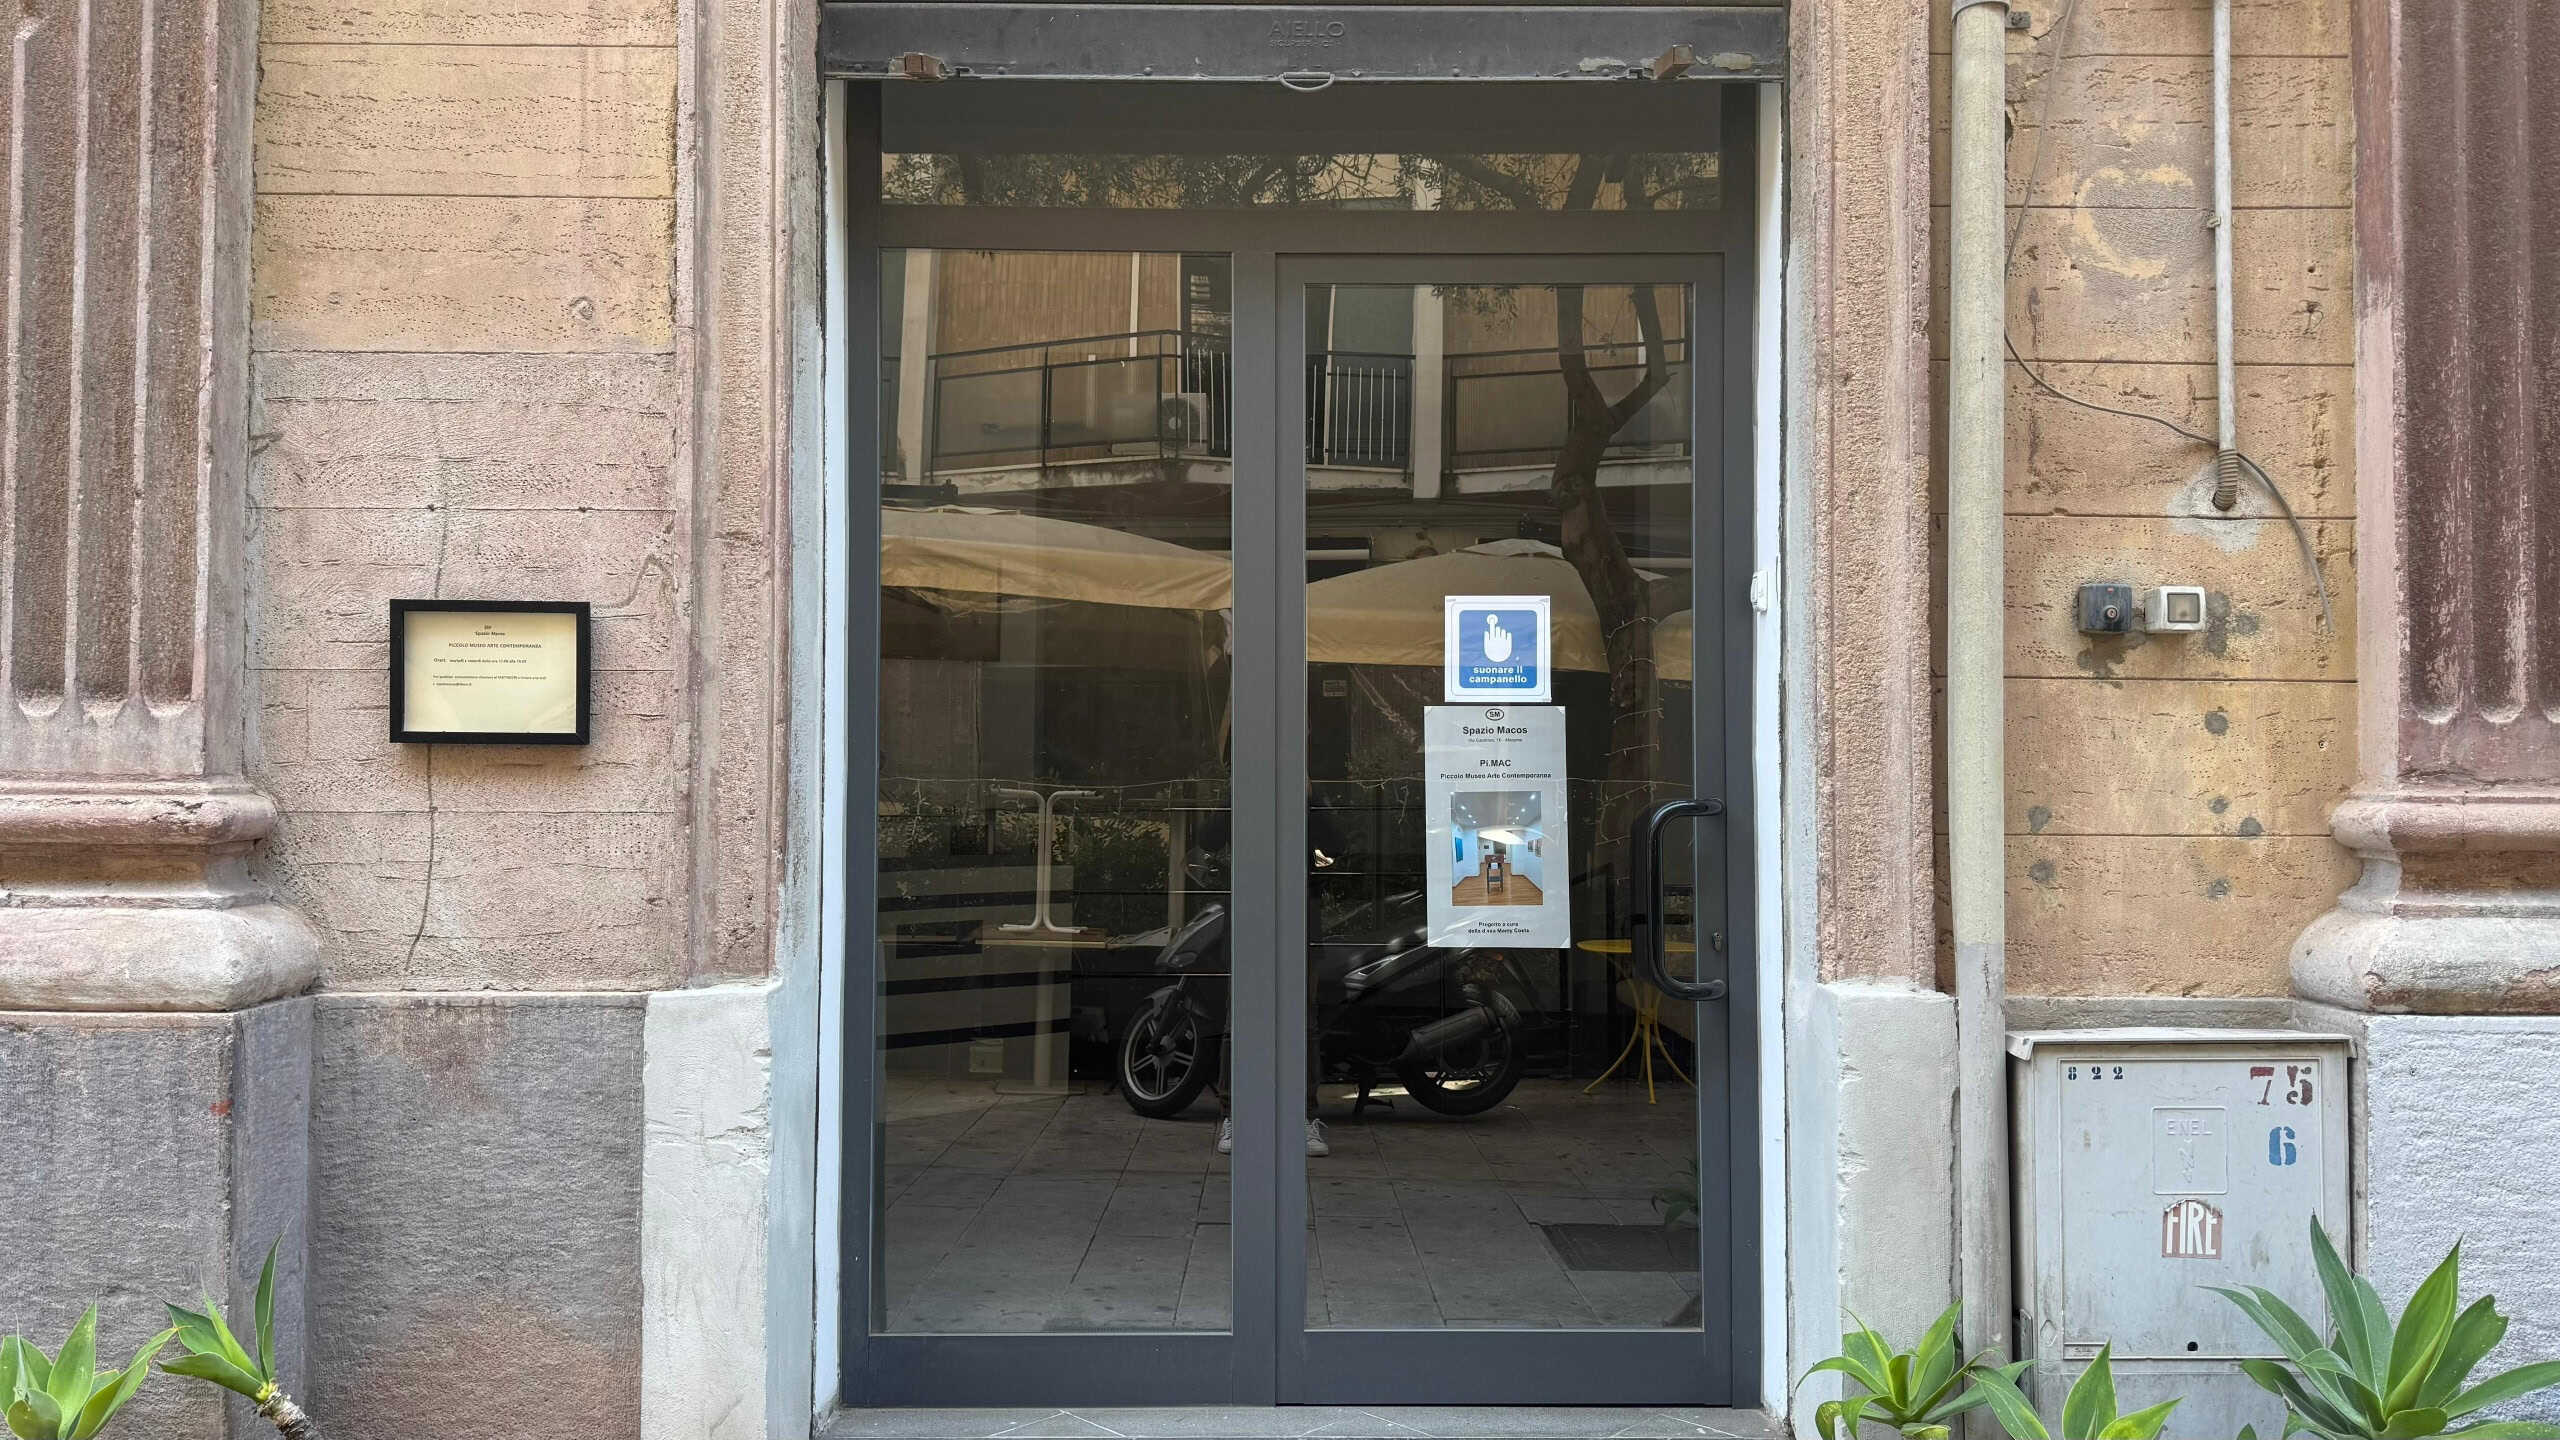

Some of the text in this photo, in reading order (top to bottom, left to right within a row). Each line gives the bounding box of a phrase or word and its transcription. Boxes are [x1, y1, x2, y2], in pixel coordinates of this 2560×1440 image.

[1473, 665, 1523, 674] suonare il
[1468, 674, 1528, 684] campanello
[1462, 726, 1528, 736] Spazio Macos
[1479, 759, 1512, 767] Pi.MAC
[2250, 1065, 2314, 1106] 75
[2166, 1119, 2213, 1136] ENEL
[2268, 1126, 2297, 1166] 6
[2164, 1199, 2217, 1256] FIRE
